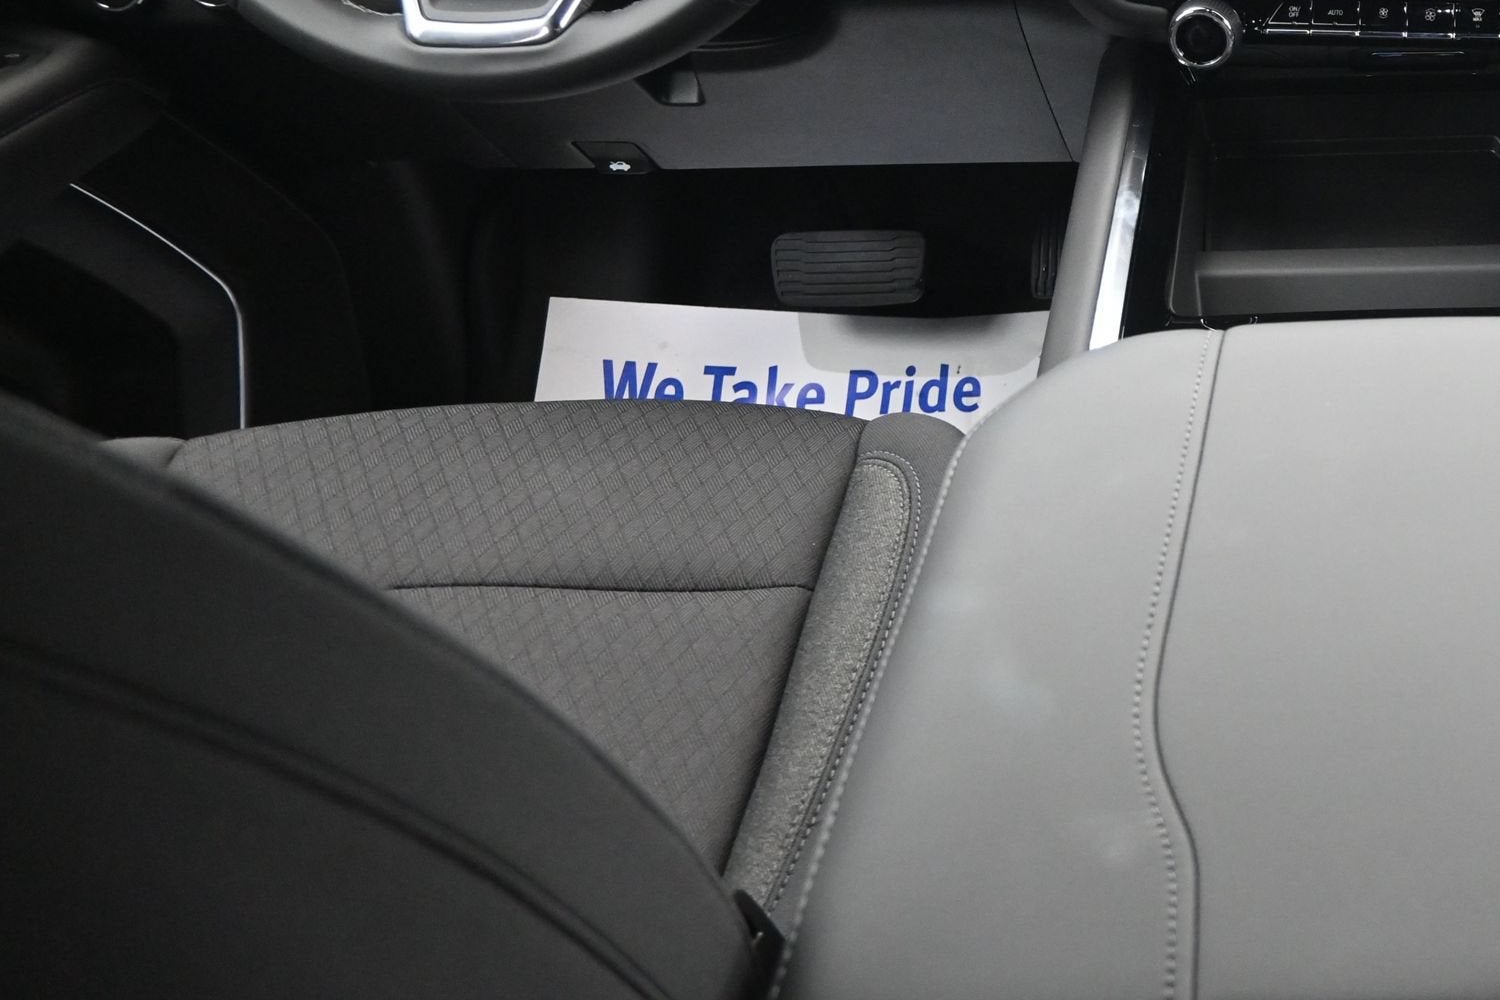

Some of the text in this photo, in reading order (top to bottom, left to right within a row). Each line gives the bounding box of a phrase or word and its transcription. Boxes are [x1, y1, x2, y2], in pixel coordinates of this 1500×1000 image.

[602, 359, 983, 418] We Take Pride
